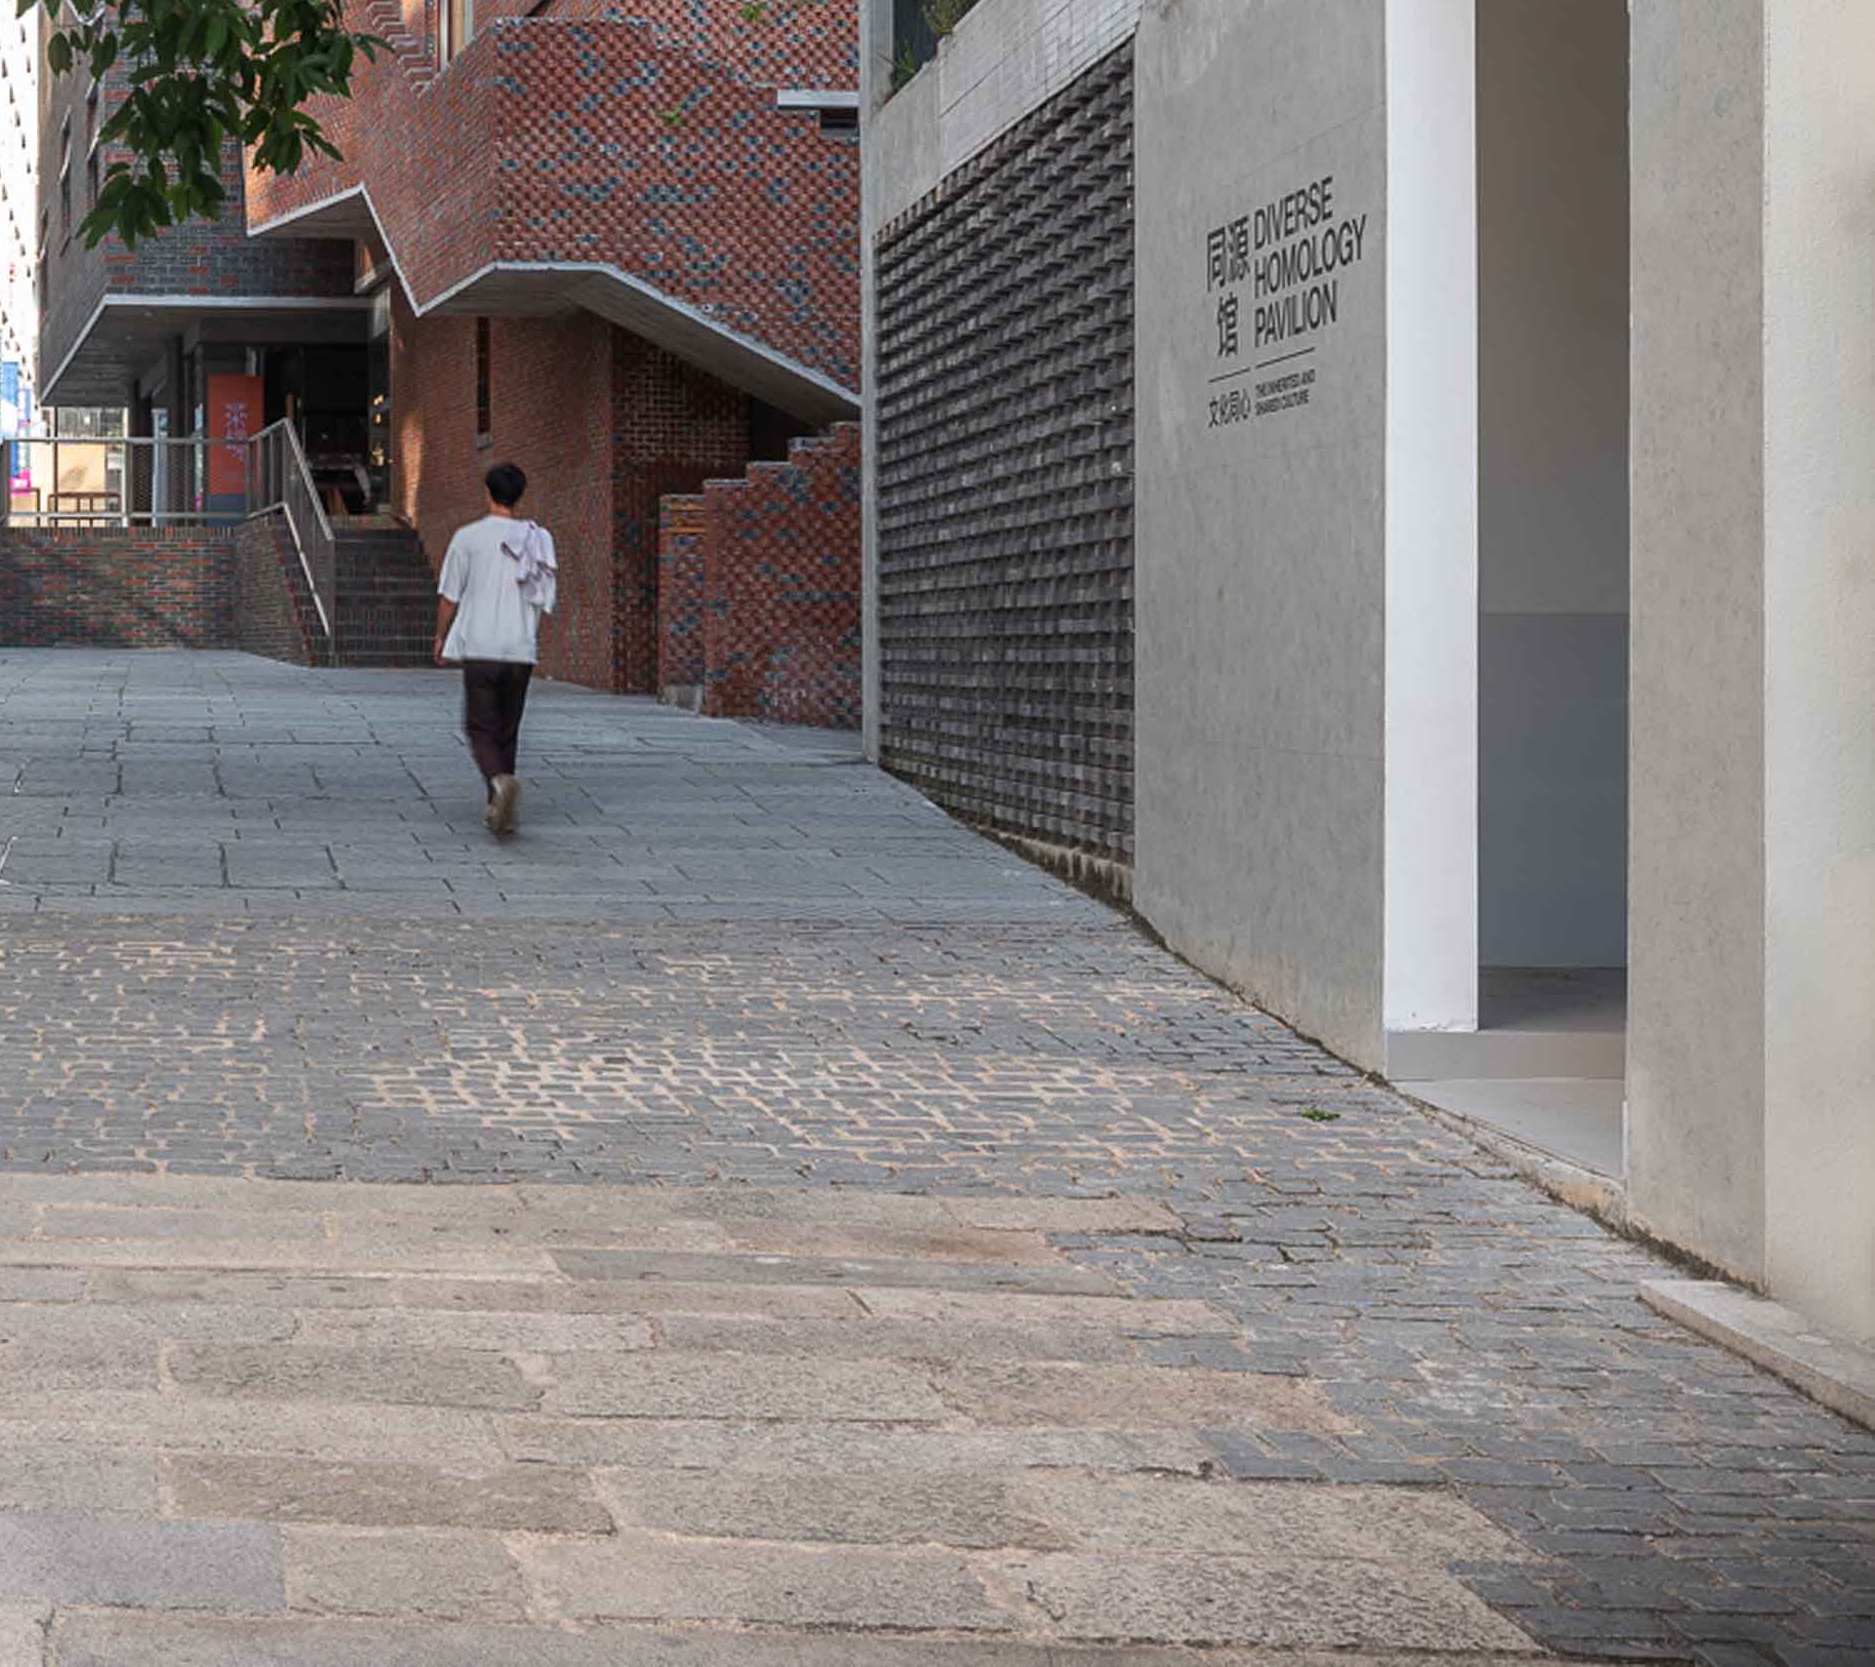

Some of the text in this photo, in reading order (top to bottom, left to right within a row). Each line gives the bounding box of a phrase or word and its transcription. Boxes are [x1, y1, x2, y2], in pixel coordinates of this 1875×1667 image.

[1254, 175, 1334, 251] DIVERSE
[1254, 213, 1367, 300] HOMOLOGY
[1254, 279, 1338, 348] PAVILION
